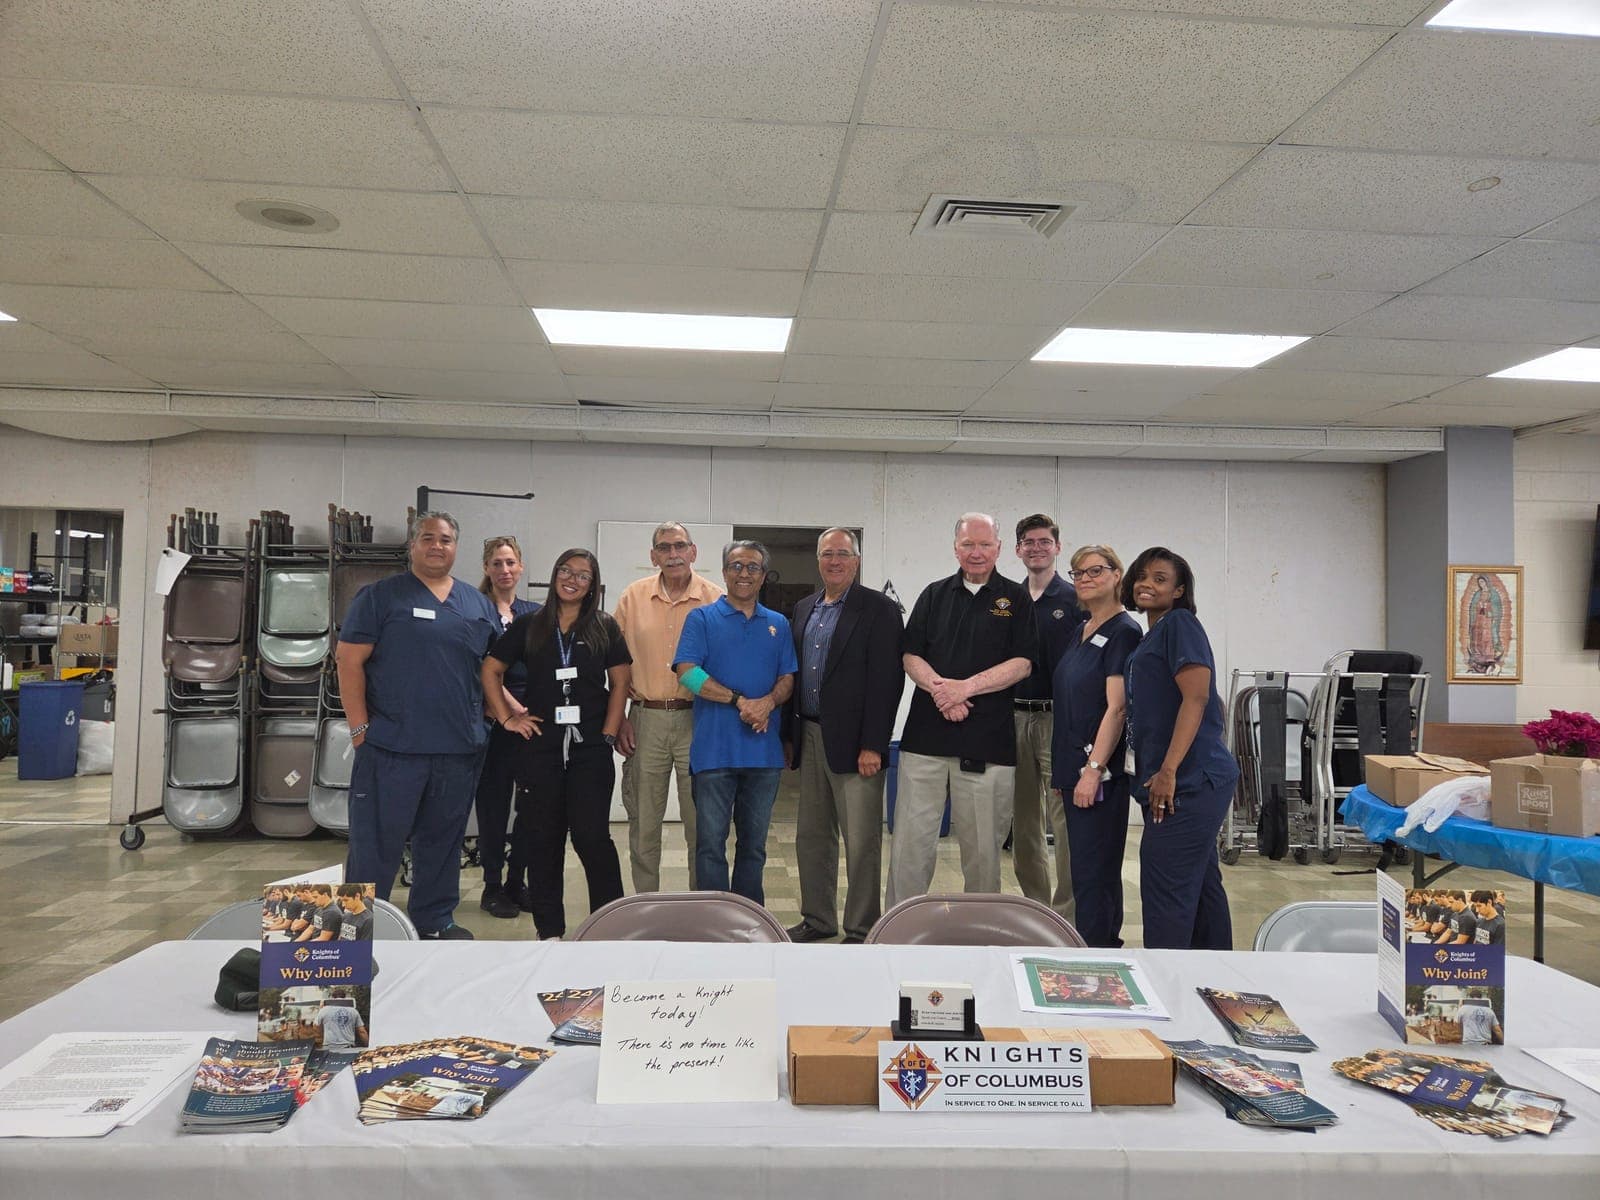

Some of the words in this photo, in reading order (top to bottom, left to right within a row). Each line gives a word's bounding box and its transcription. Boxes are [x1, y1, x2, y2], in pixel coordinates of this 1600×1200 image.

[311, 948, 332, 956] Knights
[280, 967, 313, 981] Why
[314, 966, 353, 978] Join?
[1422, 967, 1451, 981] Why
[1453, 968, 1488, 979] Join?
[611, 985, 665, 1003] Become
[696, 984, 734, 1006] Knight
[651, 1005, 705, 1028] today!
[618, 1037, 651, 1051] There
[679, 1040, 694, 1049] no
[701, 1037, 727, 1049] time
[735, 1036, 755, 1049] like
[944, 1046, 1083, 1063] KNIGHTS
[645, 1057, 661, 1070] the
[669, 1055, 724, 1074] present!
[899, 1059, 905, 1068] K
[918, 1059, 926, 1068] C
[432, 1066, 462, 1080] Why
[462, 1072, 500, 1084] Join?
[945, 1074, 971, 1088] OF
[975, 1074, 1084, 1088] COLUMBUS
